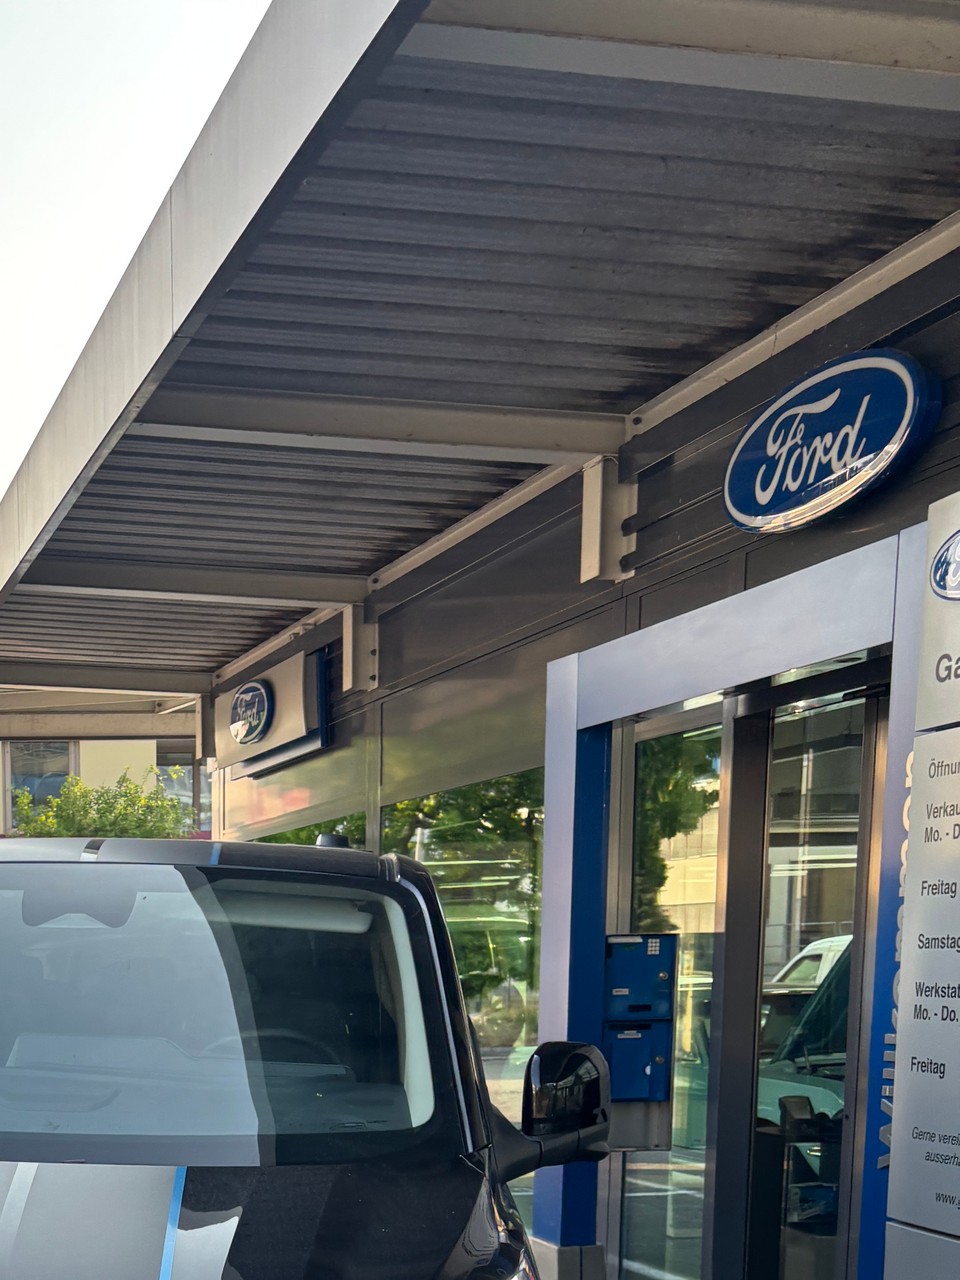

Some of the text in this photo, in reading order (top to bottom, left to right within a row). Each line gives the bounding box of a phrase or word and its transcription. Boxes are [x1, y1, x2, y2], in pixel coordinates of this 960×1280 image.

[754, 387, 872, 506] Ford
[924, 826, 942, 844] Mo.
[920, 879, 957, 899] Freitag
[913, 1004, 931, 1021] Mo.
[940, 1005, 959, 1022] Do.
[910, 1055, 946, 1080] Freitag
[911, 1126, 937, 1143] Gerne
